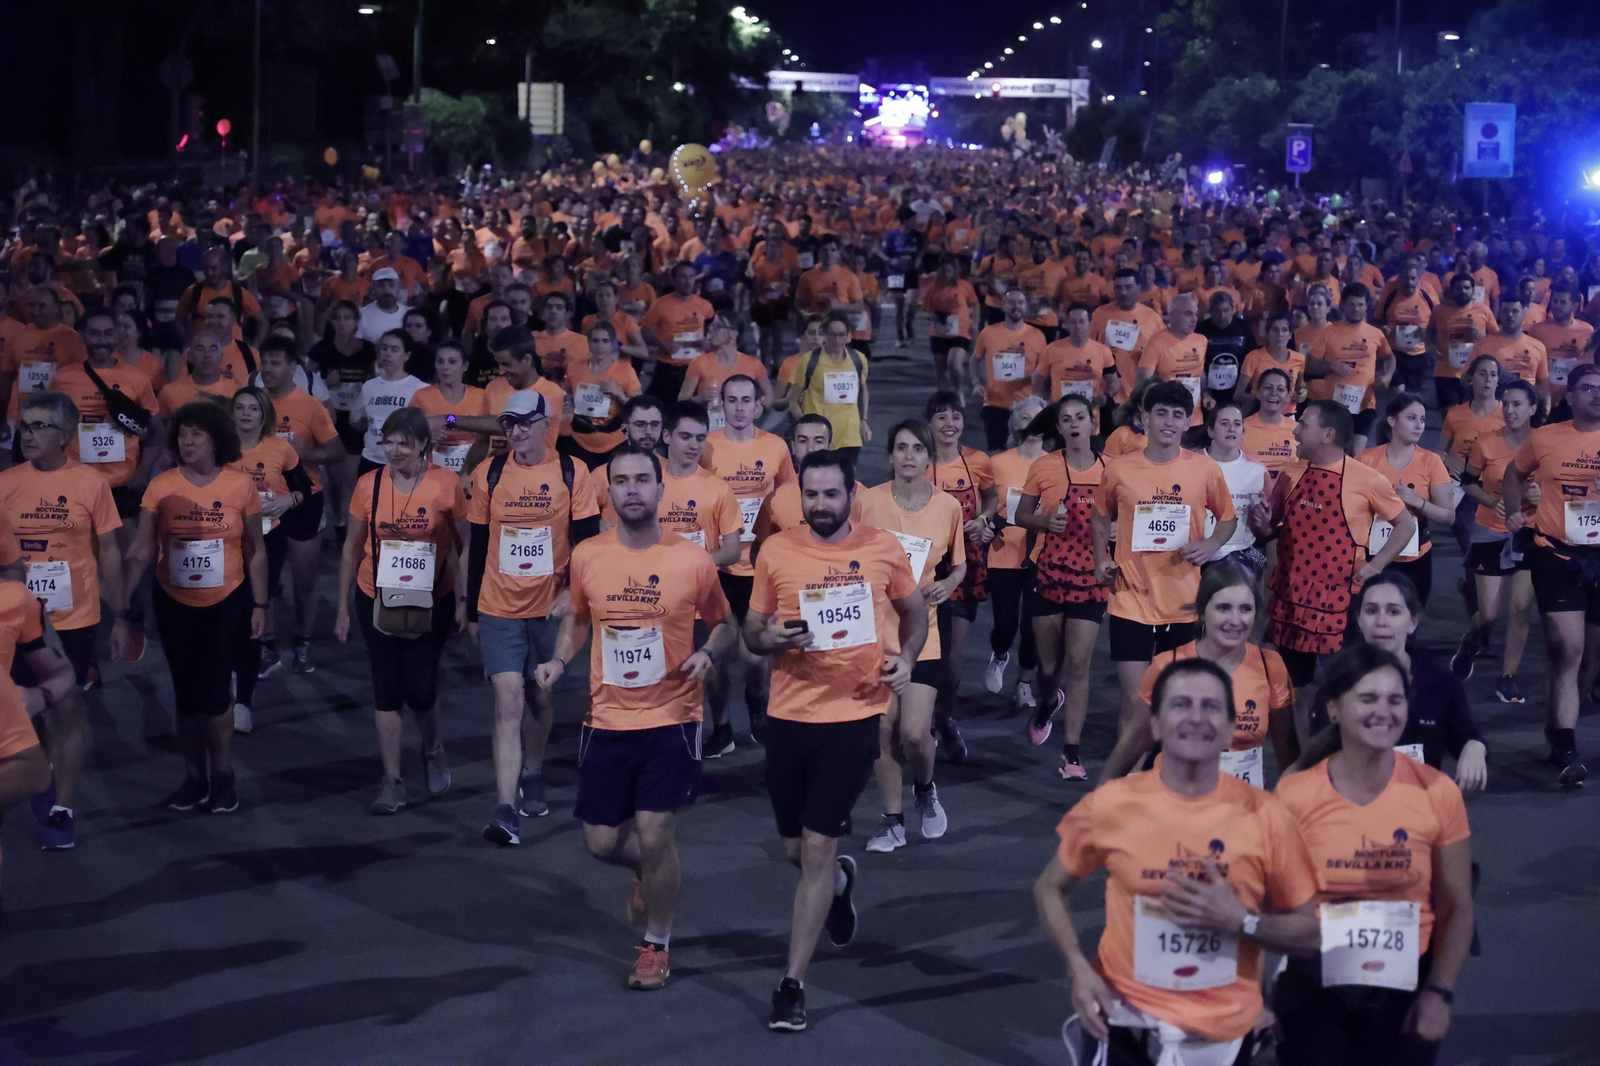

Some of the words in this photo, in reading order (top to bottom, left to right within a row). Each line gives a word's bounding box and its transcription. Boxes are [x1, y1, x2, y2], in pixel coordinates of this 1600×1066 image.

[1114, 329, 1131, 339] 3640
[1001, 362, 1017, 370] 3641
[28, 372, 49, 381] 12558
[833, 382, 854, 391] 10831
[92, 436, 115, 447] 5326
[742, 512, 756, 524] 27
[1148, 519, 1176, 532] 4656
[510, 543, 544, 557] 21685
[182, 556, 211, 568] 4175
[391, 556, 426, 570] 21686
[823, 574, 865, 582] NOCTURNA
[27, 579, 57, 592] 4174
[622, 587, 662, 597] NOCTURNA
[606, 594, 640, 602] SEVILLA
[817, 605, 861, 625] 19545
[614, 647, 652, 664] 11974
[1355, 849, 1412, 858] NOCTURNA
[1326, 858, 1381, 869] SEVILLA
[1157, 931, 1221, 954] 15726
[1345, 928, 1405, 952] 15728
